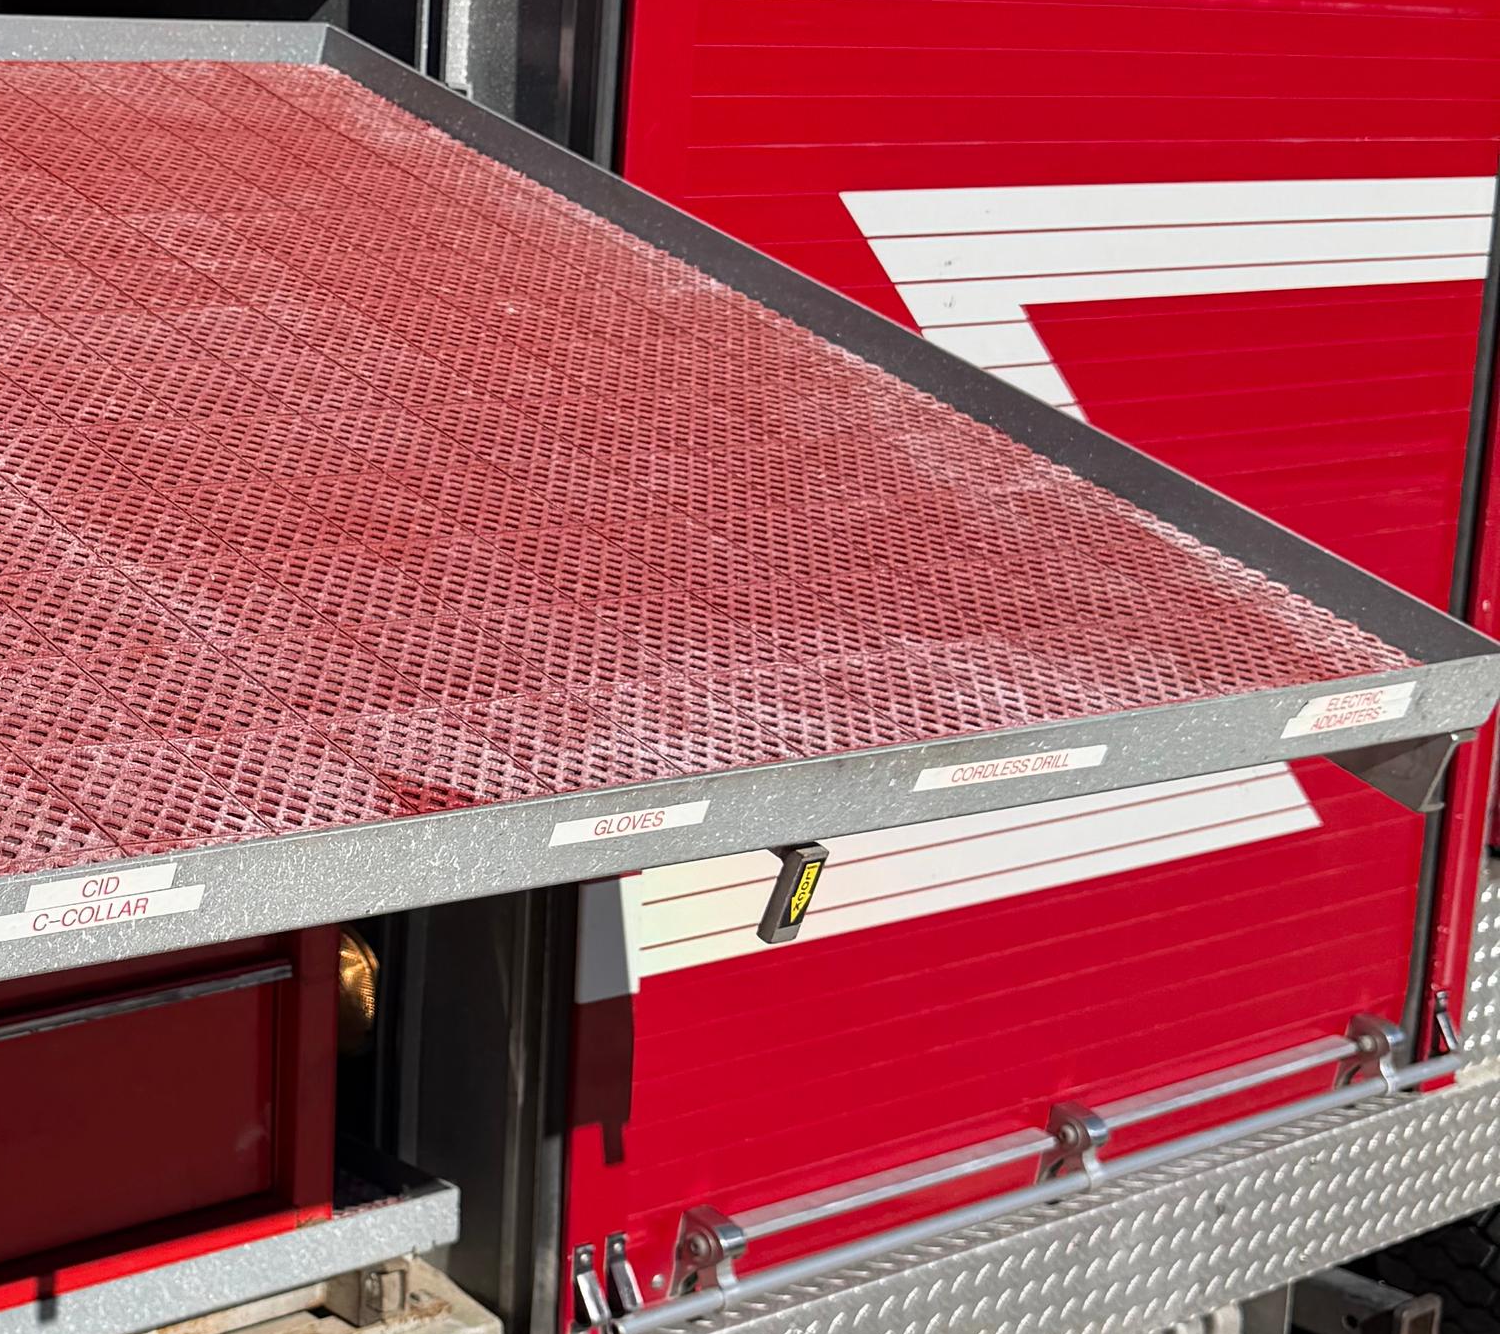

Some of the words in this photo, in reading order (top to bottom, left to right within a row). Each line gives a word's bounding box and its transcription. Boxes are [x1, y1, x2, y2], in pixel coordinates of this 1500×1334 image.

[1326, 690, 1384, 712] ELECTRIC
[951, 758, 1029, 783] CORDLESS
[1031, 753, 1069, 772] DRILL
[594, 810, 666, 837] GLOVES
[82, 875, 120, 898] CID
[33, 897, 149, 932] C-COLLAR
